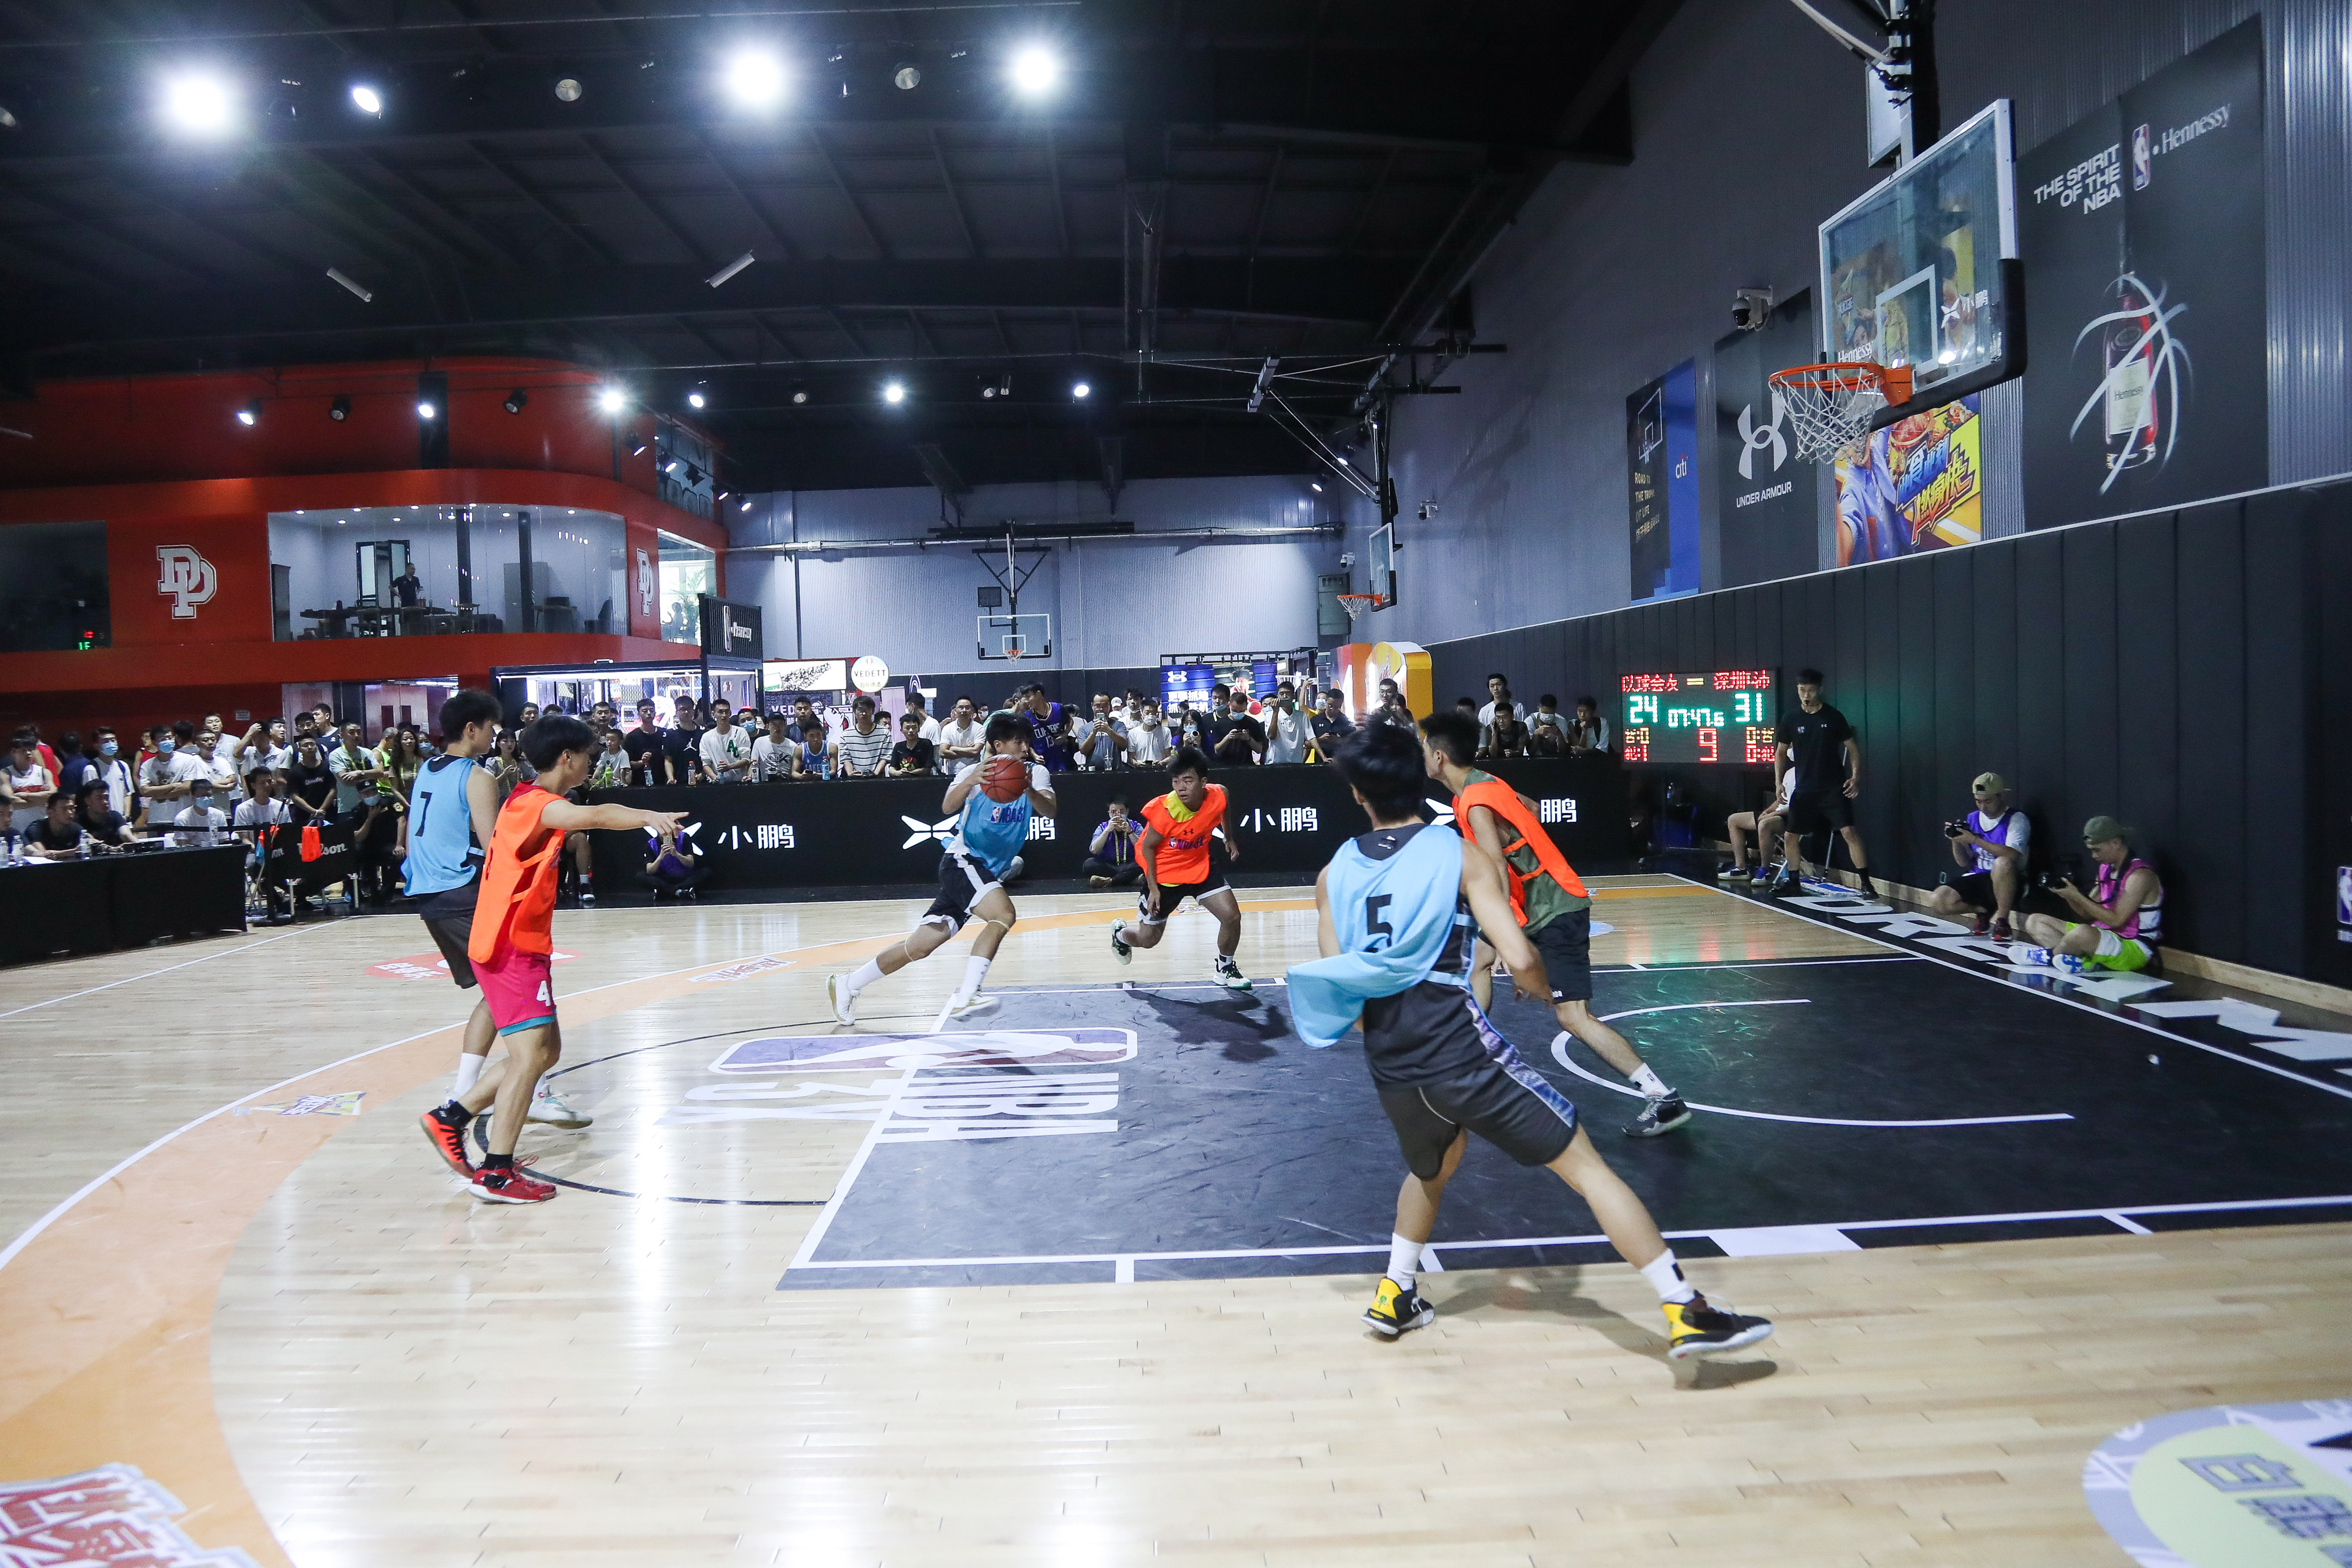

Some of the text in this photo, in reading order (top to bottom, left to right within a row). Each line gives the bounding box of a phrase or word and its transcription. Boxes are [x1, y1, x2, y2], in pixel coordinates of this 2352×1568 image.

[2162, 104, 2230, 154] Hennessy
[2034, 143, 2120, 204] THE SPIRIT
[2060, 162, 2121, 207] OF THE
[2083, 183, 2121, 215] NBA
[1838, 341, 1873, 363] Hennessy
[1635, 472, 1646, 484] ROAD
[1676, 459, 1687, 479] citi
[1736, 481, 1792, 508] UNDER ARMOUR
[1621, 673, 1678, 692] 以球会友
[1629, 695, 1658, 723] 24
[1735, 693, 1762, 722] 31
[1046, 735, 1054, 748] 13
[1699, 727, 1718, 761] 9
[415, 791, 432, 837] 7
[1240, 807, 1318, 833] 小鹏
[717, 824, 795, 850] 小鹏
[1364, 893, 1394, 952] 5
[875, 1072, 1119, 1144] NBA
